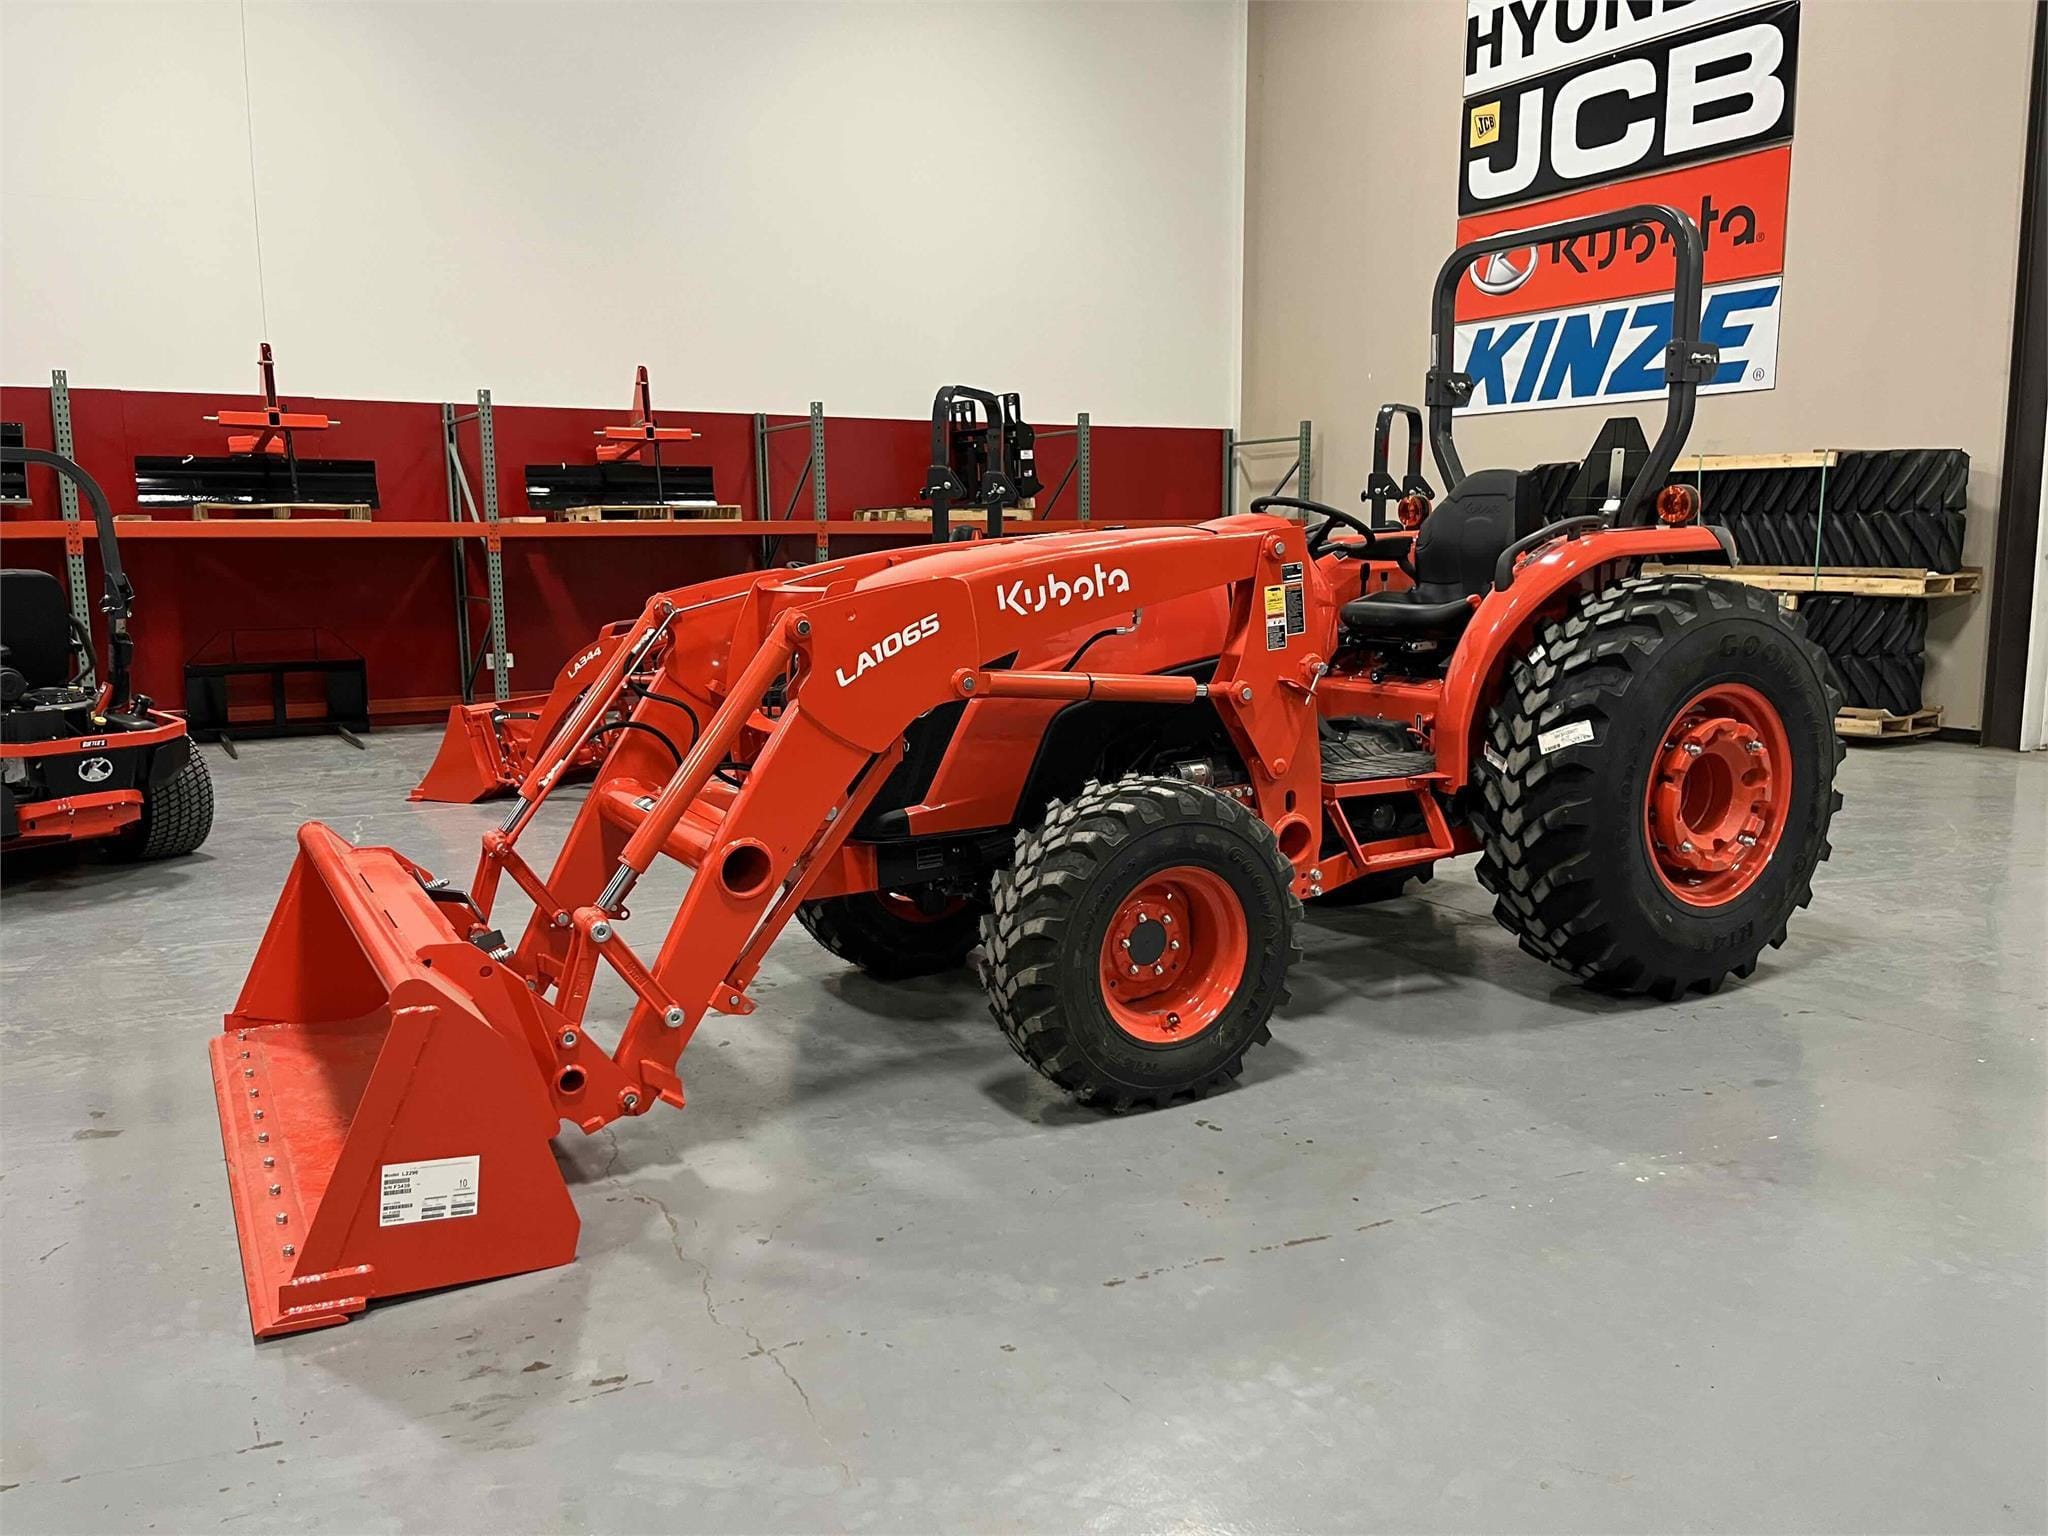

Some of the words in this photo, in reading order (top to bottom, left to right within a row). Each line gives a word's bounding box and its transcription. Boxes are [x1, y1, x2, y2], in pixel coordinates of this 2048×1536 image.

[1466, 0, 1691, 76] HYU
[1468, 23, 1785, 200] JCB
[1477, 115, 1496, 135] JCB
[1464, 286, 1780, 409] KINZE
[996, 563, 1130, 616] Kubota
[567, 646, 602, 679] LA344
[834, 612, 941, 688] LA1065
[460, 1178, 468, 1188] 10
